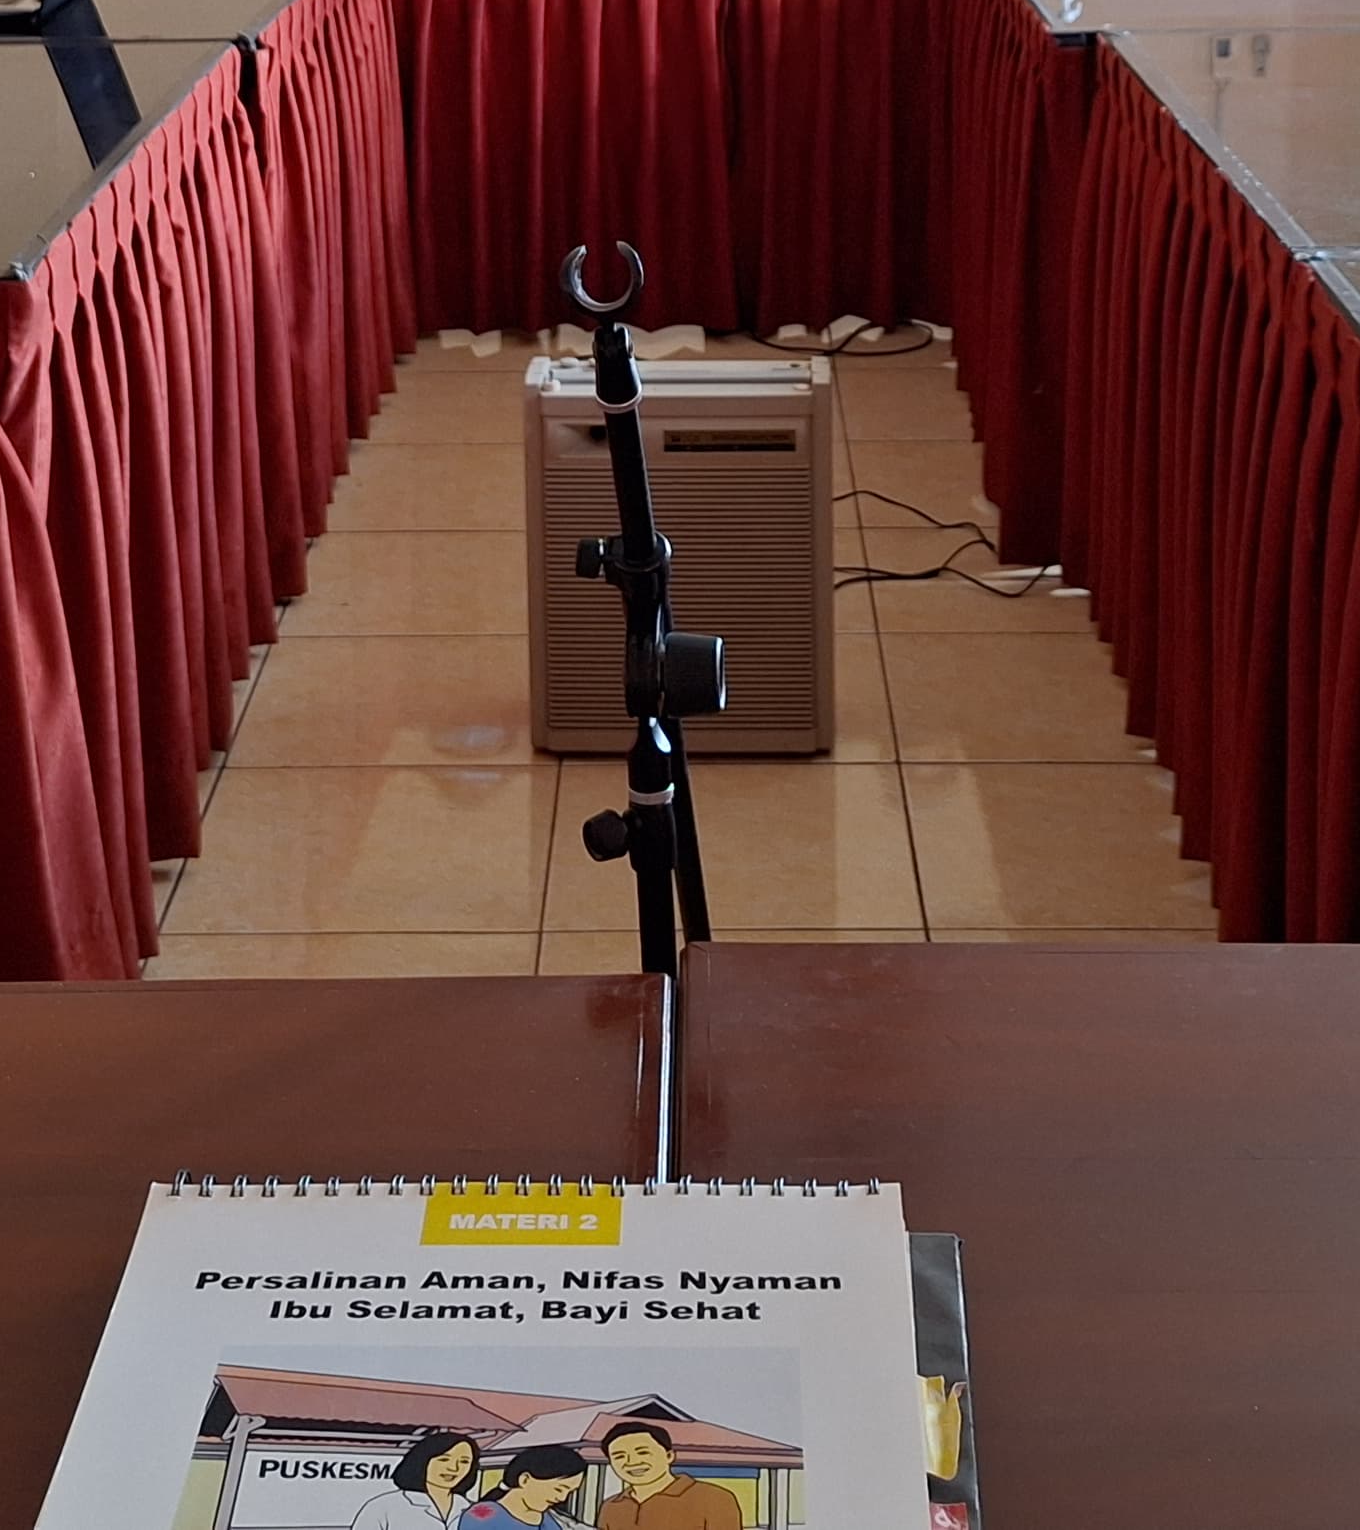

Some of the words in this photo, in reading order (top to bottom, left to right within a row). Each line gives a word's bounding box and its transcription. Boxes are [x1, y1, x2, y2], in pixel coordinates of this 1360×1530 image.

[450, 1214, 568, 1229] MATERI
[580, 1215, 597, 1230] 2
[196, 1272, 405, 1289] Persalinan
[421, 1272, 545, 1293] Aman,
[563, 1271, 664, 1289] Nifas
[681, 1272, 841, 1294] Nyaman
[270, 1301, 331, 1318] Ibu
[347, 1301, 523, 1323] Selamat,
[542, 1301, 627, 1324] Bayi
[644, 1301, 760, 1319] Sehat
[259, 1459, 395, 1479] PUSKESM
